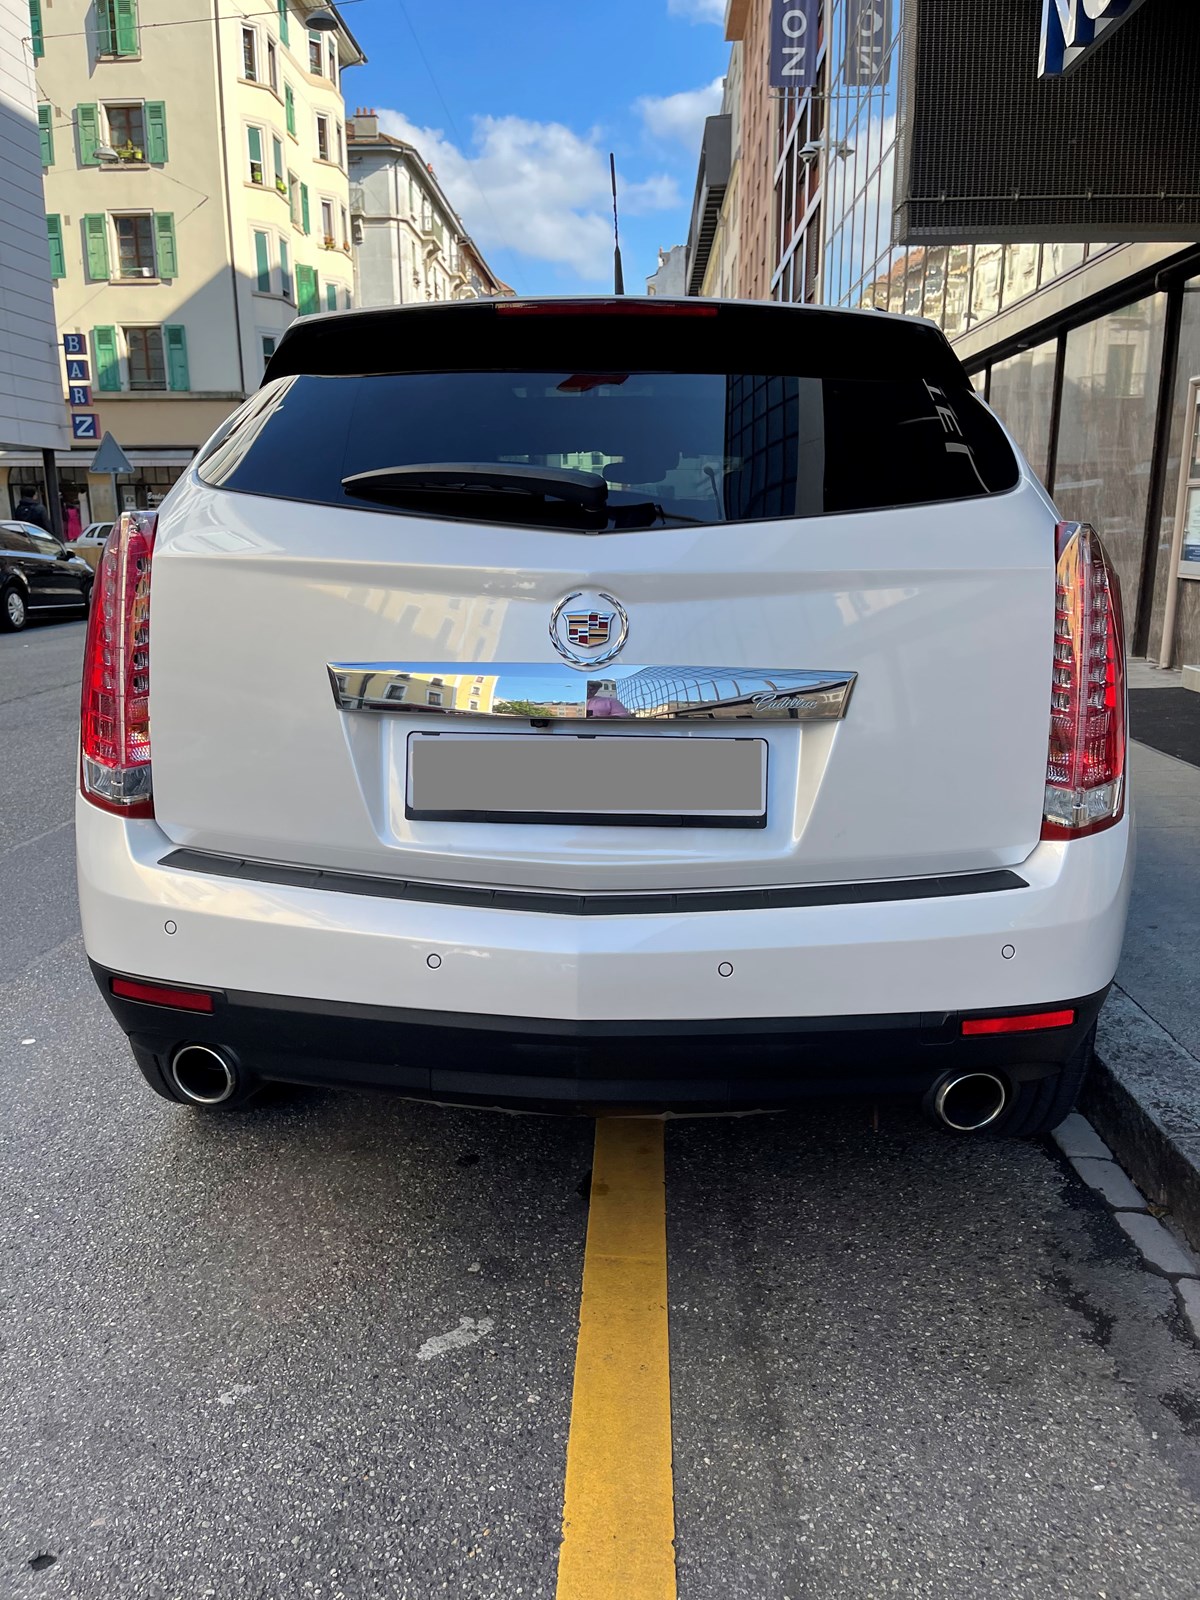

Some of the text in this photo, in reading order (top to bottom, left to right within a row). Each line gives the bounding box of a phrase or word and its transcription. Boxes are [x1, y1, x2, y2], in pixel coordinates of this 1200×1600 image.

[781, 0, 808, 76] NO
[1037, 0, 1114, 79] N
[752, 693, 818, 712] Cadillac
